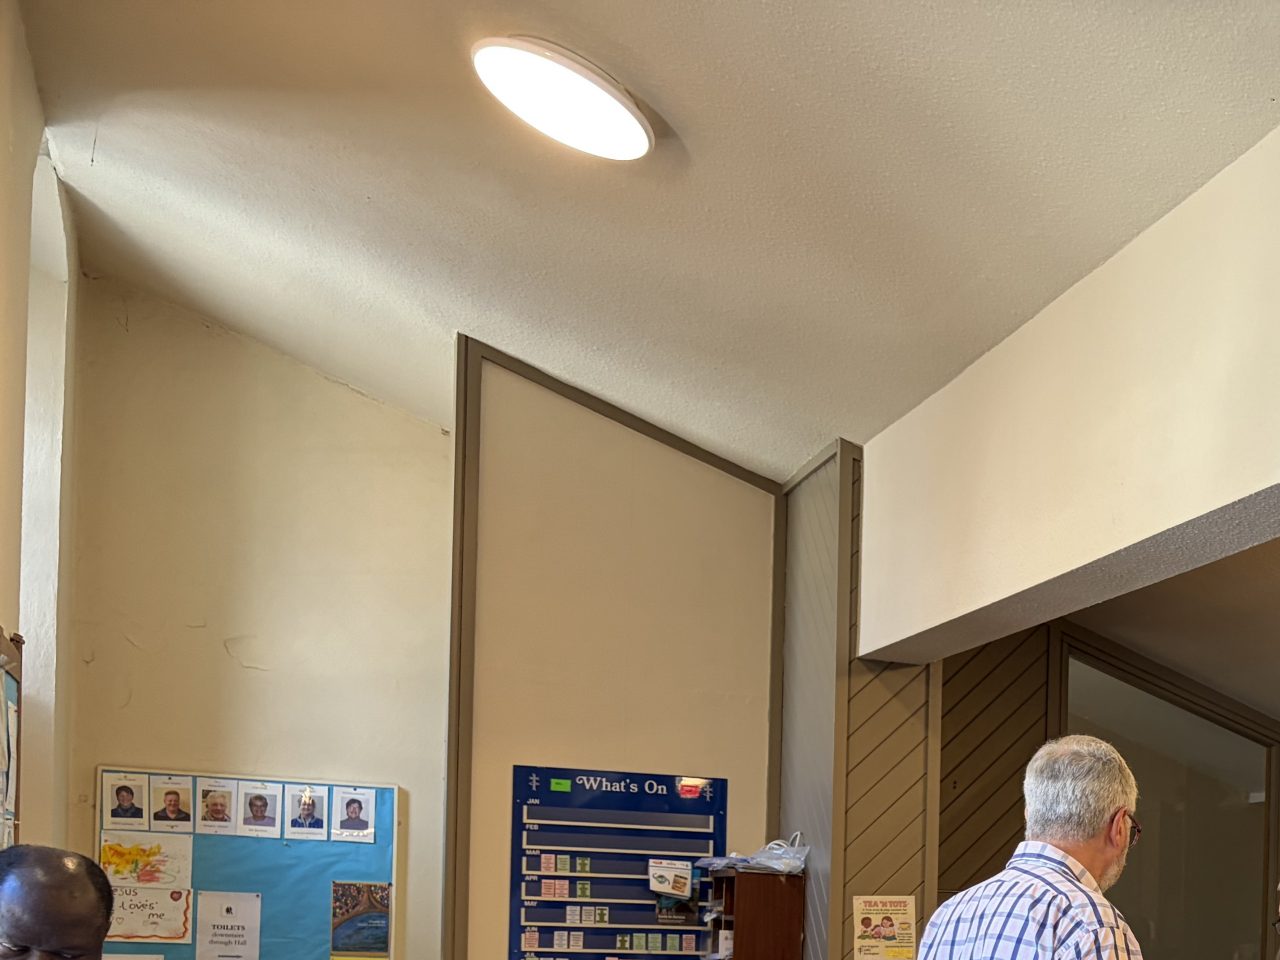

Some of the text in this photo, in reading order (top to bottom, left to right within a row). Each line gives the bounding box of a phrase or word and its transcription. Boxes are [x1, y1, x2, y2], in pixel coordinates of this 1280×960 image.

[576, 775, 668, 795] What's On
[113, 887, 138, 896] esus
[148, 911, 165, 920] me
